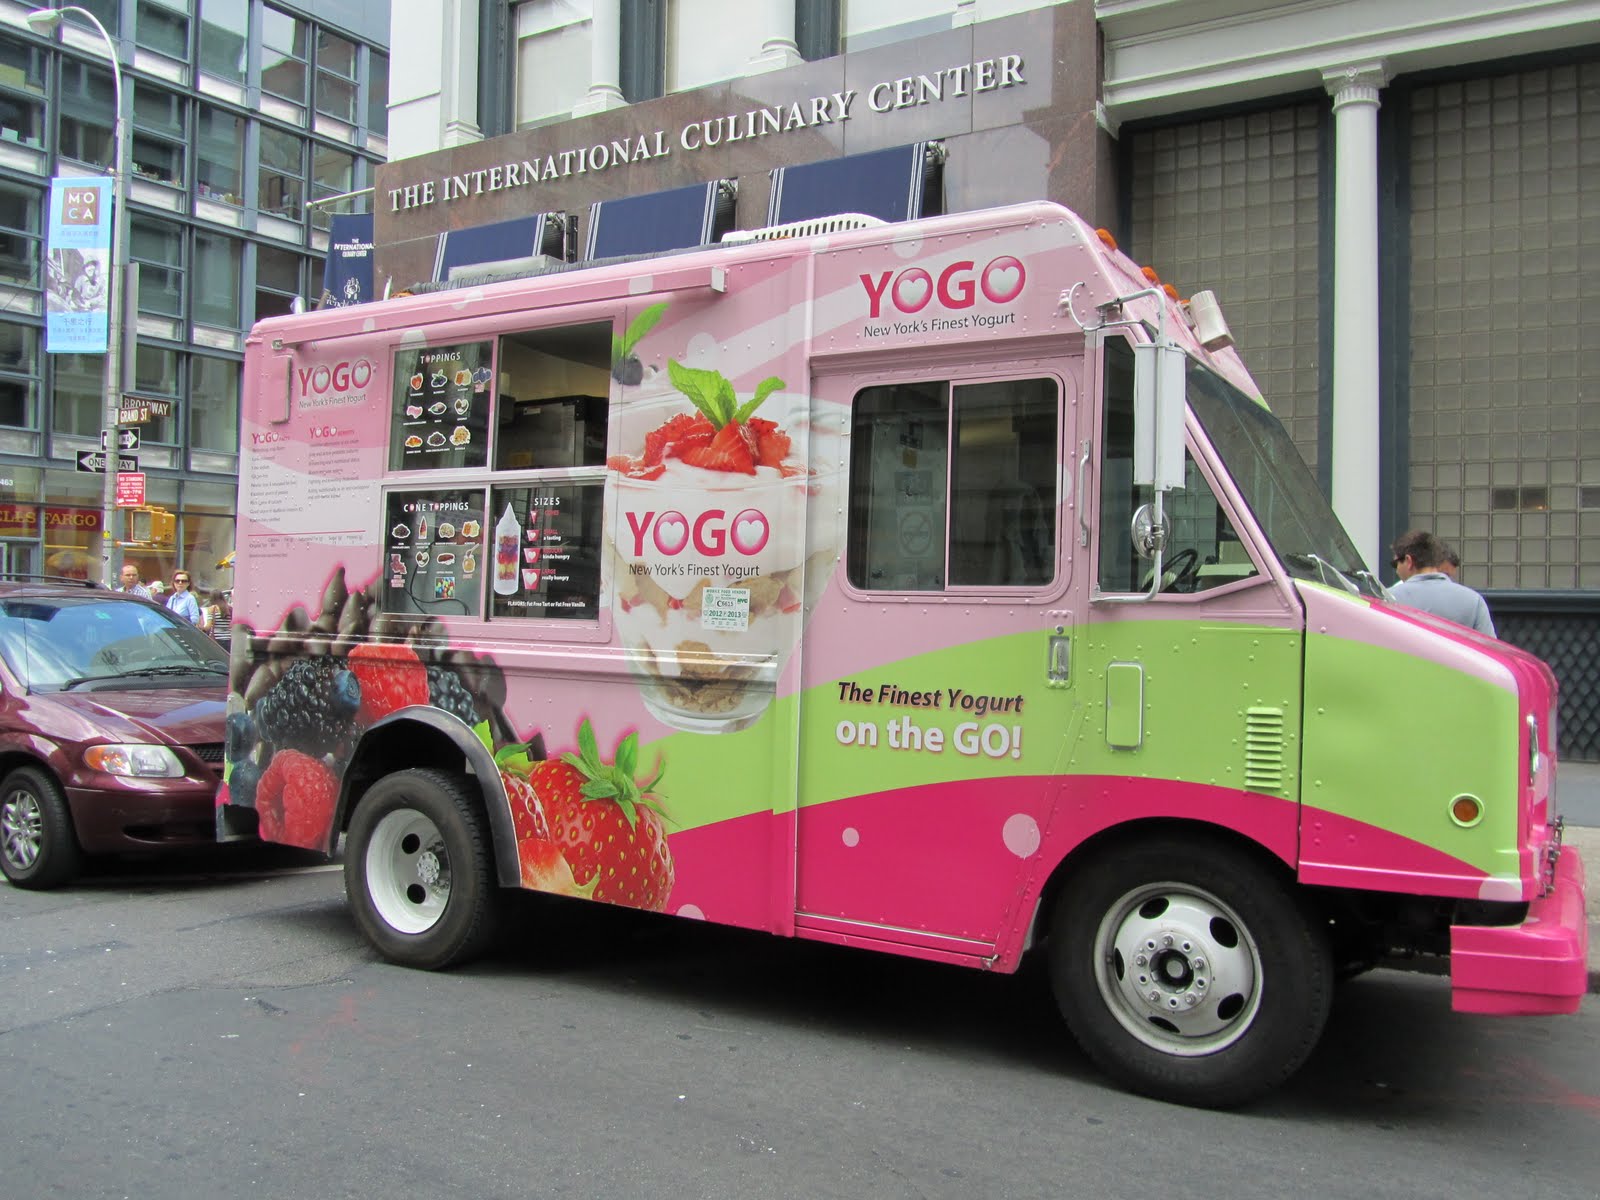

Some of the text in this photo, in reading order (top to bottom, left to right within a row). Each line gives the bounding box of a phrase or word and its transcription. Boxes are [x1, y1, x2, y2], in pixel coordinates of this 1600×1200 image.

[388, 54, 1024, 211] THE INTERNATIONAL CULINARY CENTER
[859, 255, 1026, 319] YOGO
[864, 312, 1015, 337] New York's Finest Yogurt
[420, 352, 461, 364] TOPPINGS
[298, 359, 371, 396] YOGO
[299, 394, 366, 409] New York's Finest Yogurt
[120, 408, 148, 423] GRAND ST
[252, 432, 279, 444] YOGO
[310, 426, 337, 439] YOGO
[88, 458, 132, 470] ONE AY
[403, 502, 469, 512] CONE TOPPINGS
[534, 497, 560, 506] SIZES
[625, 508, 770, 556] YOGO
[629, 563, 760, 579] New York's Finest Yogurt
[727, 610, 742, 618] 2013
[838, 681, 1024, 716] The Finest Yogurt
[836, 715, 1022, 759] on the GO!
